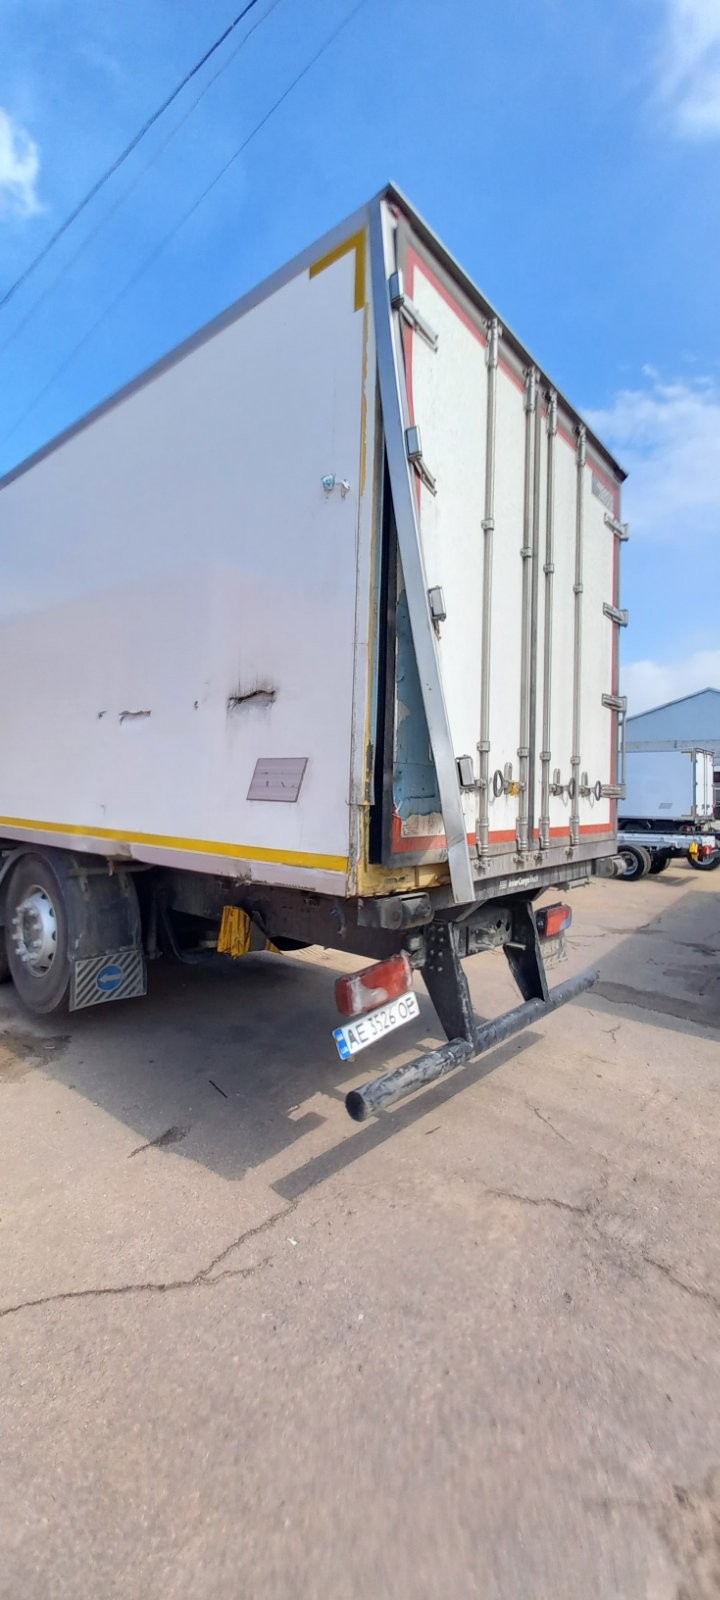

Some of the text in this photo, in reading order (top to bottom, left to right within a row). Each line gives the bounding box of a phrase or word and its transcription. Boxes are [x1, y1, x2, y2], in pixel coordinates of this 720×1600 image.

[347, 997, 416, 1048] AE 3526 OE
